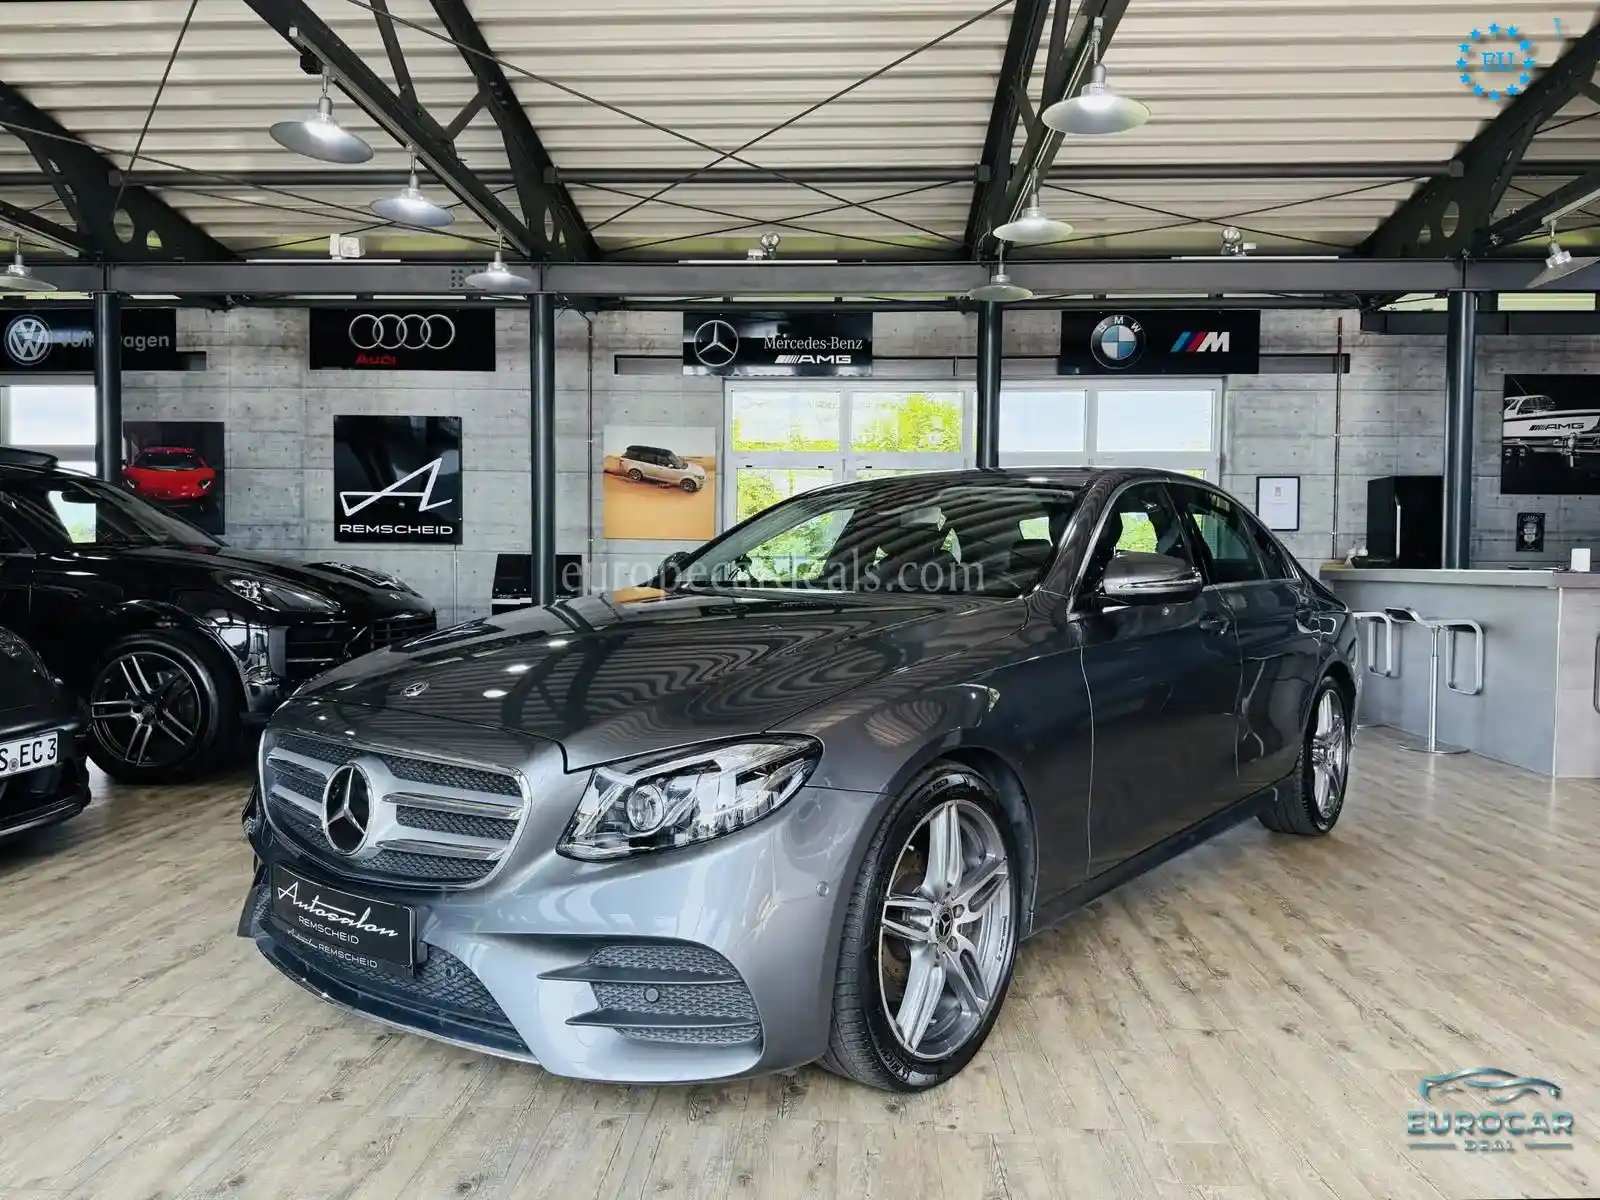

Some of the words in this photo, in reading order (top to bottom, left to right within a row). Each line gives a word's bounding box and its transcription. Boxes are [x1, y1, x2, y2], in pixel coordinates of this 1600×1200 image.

[1097, 315, 1142, 334] BMW
[763, 335, 864, 351] Mercedes-Benz
[353, 353, 397, 366] Audi
[798, 354, 853, 365] AMG
[1546, 422, 1585, 431] AMG
[339, 523, 454, 536] REMSCHEID
[20, 740, 43, 768] EC
[47, 737, 57, 761] 3
[277, 880, 399, 937] Autosalon
[297, 914, 361, 945] REMSCHEID
[318, 943, 378, 969] REMSCHEID
